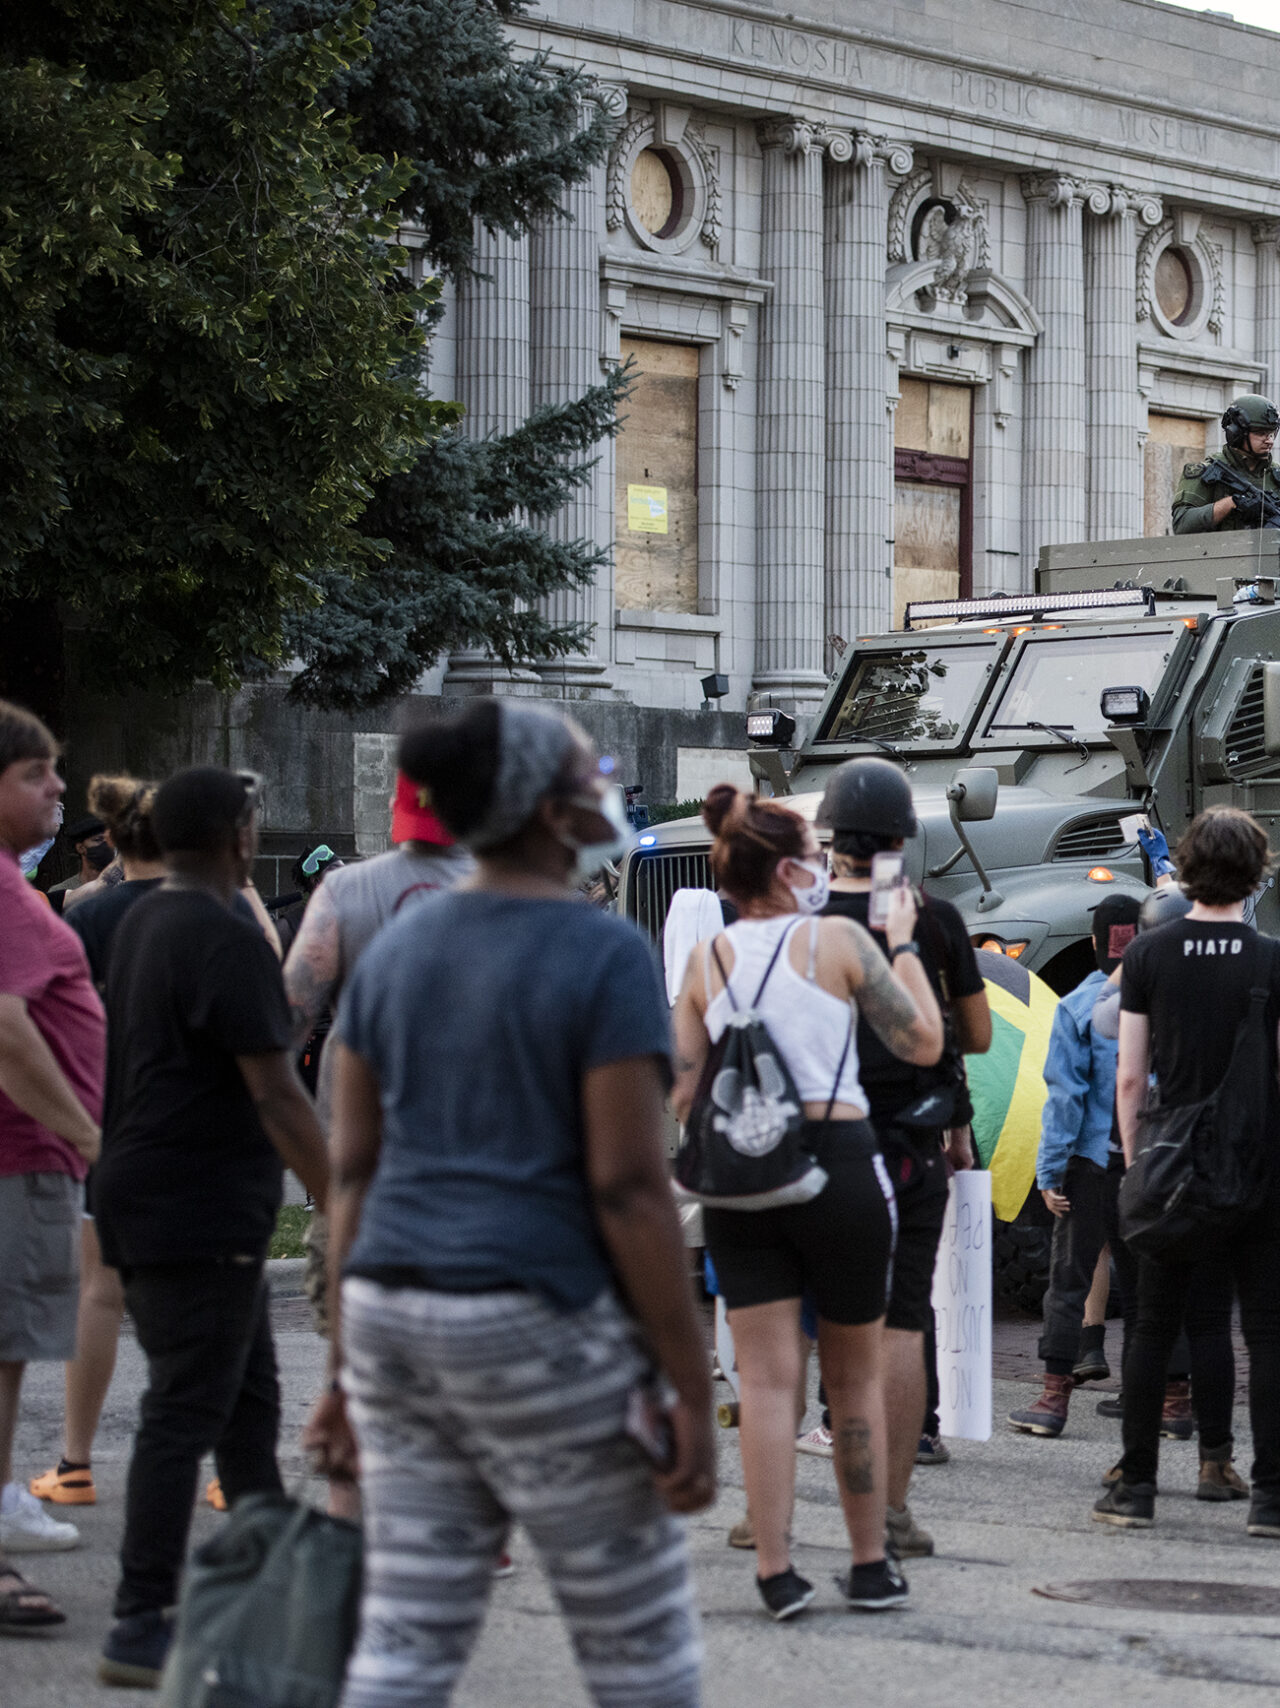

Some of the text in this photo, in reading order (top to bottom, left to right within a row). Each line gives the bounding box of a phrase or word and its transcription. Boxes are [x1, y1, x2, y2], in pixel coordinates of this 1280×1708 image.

[729, 23, 1209, 155] KENOSHA PUBLIC MUSEUM
[948, 1252, 969, 1297] NO
[951, 1365, 972, 1410] NO
